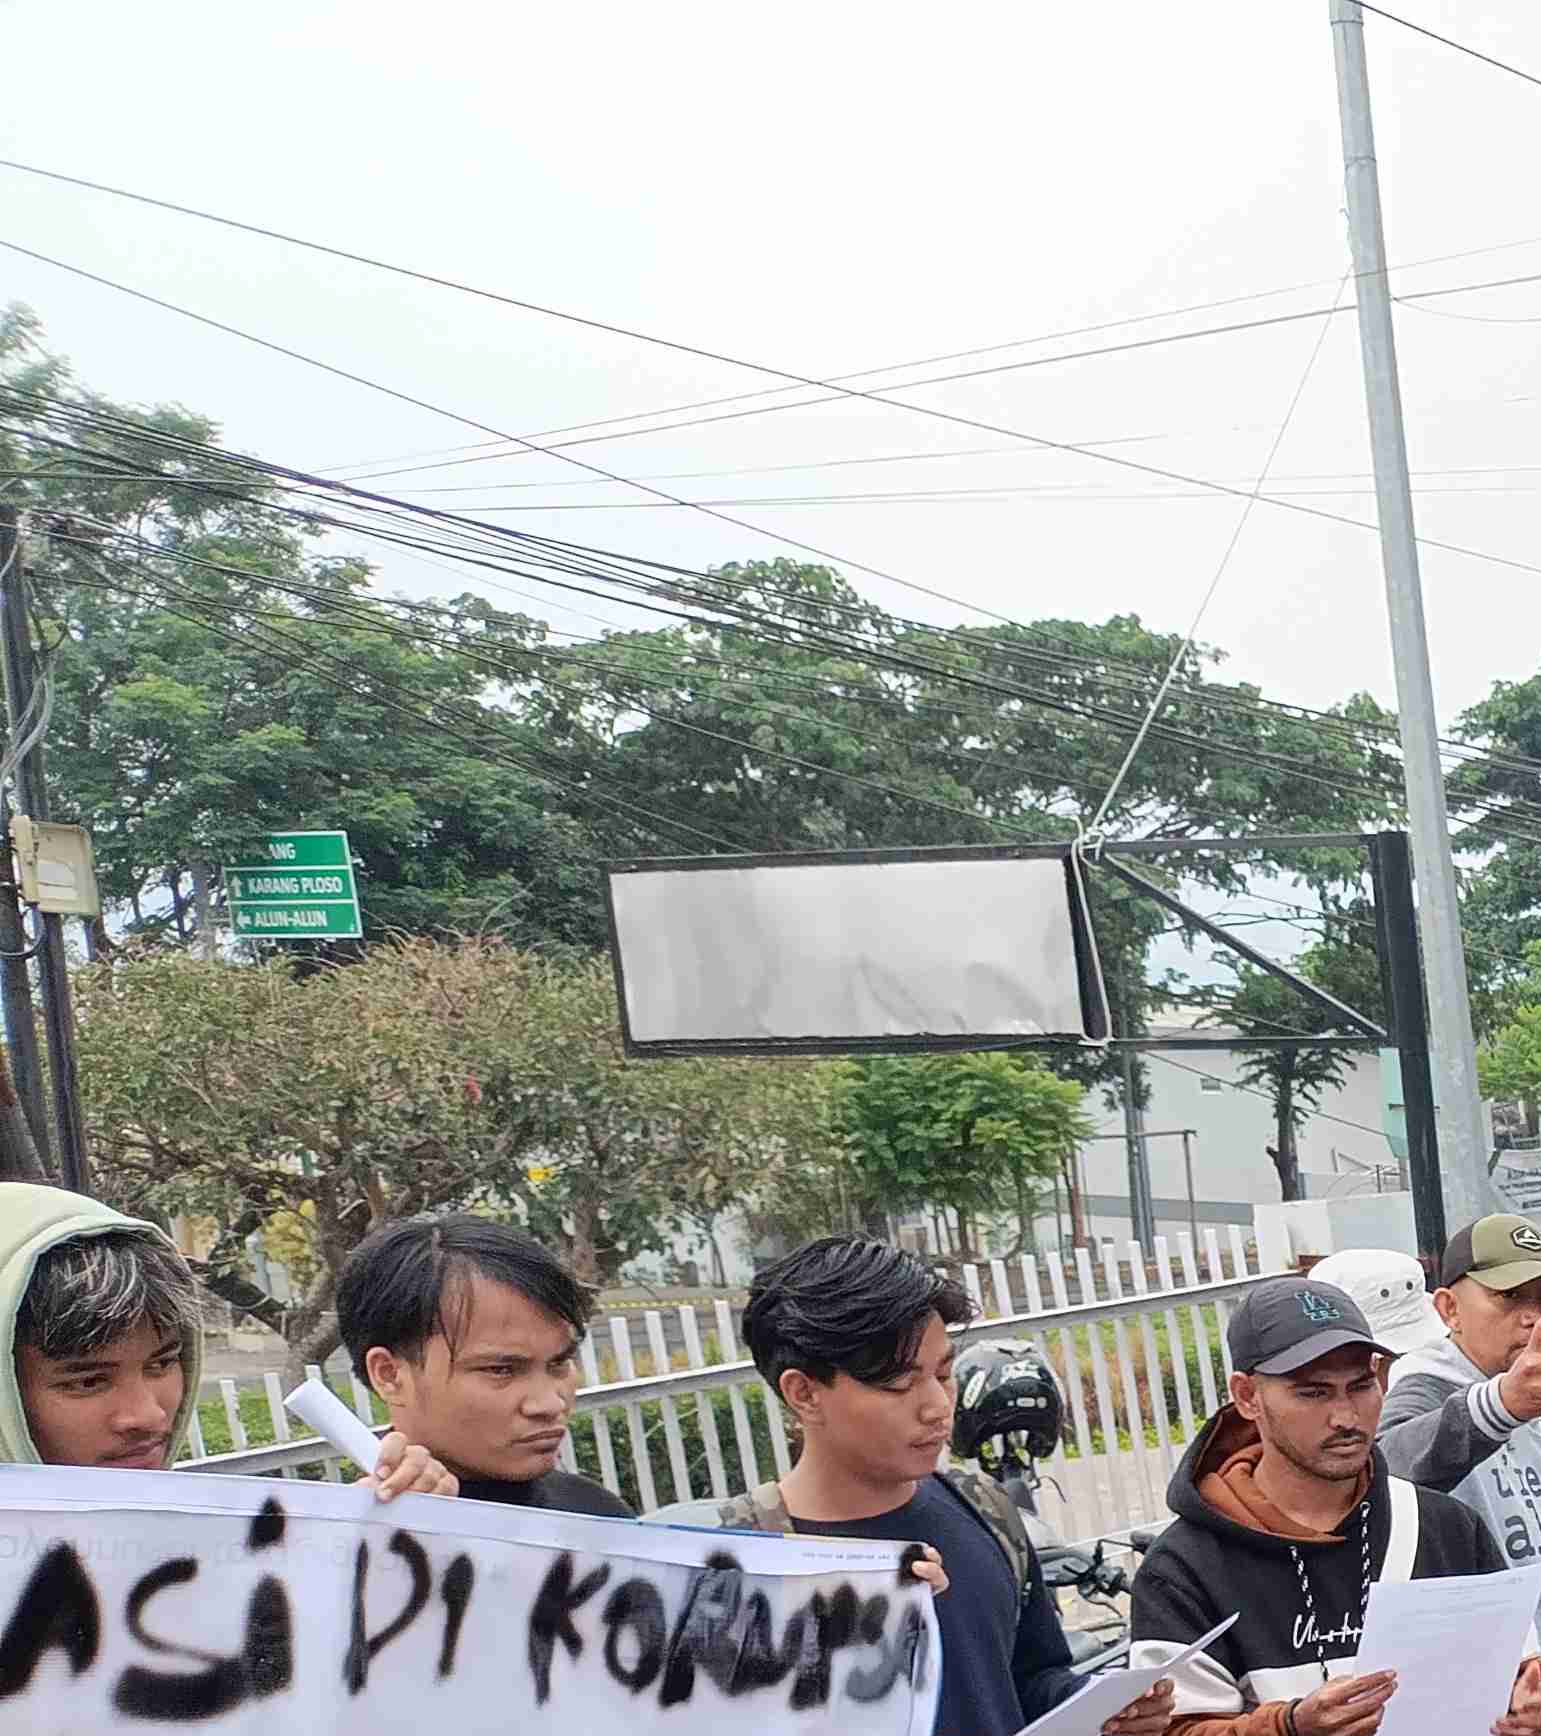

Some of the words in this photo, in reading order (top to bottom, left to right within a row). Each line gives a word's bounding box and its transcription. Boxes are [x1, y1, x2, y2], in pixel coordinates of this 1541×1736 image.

[249, 876, 299, 895] KARANG
[301, 876, 343, 894] PLOSO
[254, 910, 328, 928] ALUN-ALUN
